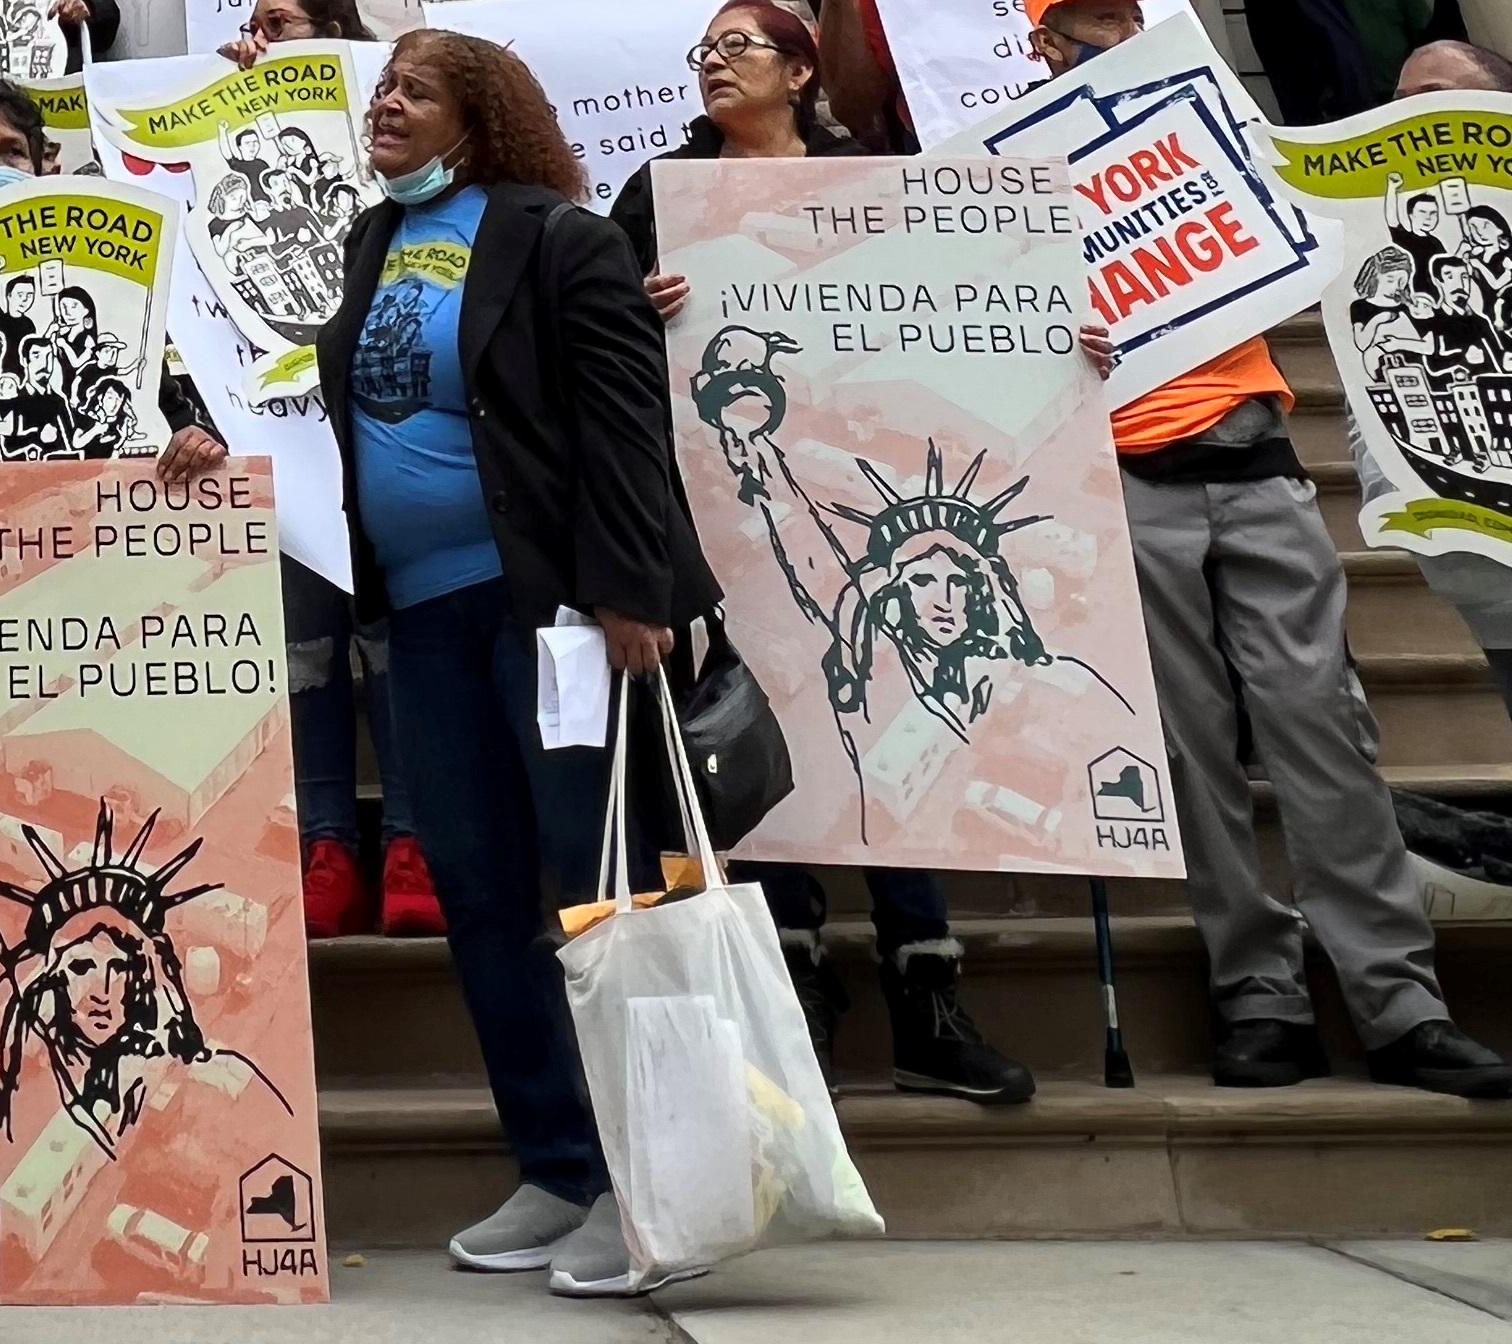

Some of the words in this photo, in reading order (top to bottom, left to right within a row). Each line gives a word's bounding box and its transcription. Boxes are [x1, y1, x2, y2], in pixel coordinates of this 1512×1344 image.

[39, 93, 87, 113] MAK
[148, 98, 215, 136] MAKE
[213, 74, 261, 109] THE
[264, 64, 337, 89] ROAD
[237, 91, 279, 119] NEW
[286, 87, 338, 104] YORK
[573, 85, 688, 116] mother
[599, 124, 667, 155] said
[1303, 141, 1387, 178] MAKE
[1389, 122, 1453, 154] THE
[902, 166, 1053, 195] HOUSE
[1074, 132, 1202, 216] YORK
[1415, 153, 1478, 175] NEW
[65, 206, 153, 243] ROAD
[803, 206, 886, 235] THE
[904, 205, 1073, 234] PEOPLE
[1083, 180, 1207, 264] MUNITIES
[19, 235, 77, 260] NEW
[87, 237, 148, 272] YORK
[1087, 201, 1259, 326] ANGE
[721, 283, 938, 318] ¡VIVIENDA
[955, 284, 1072, 314] PARA
[834, 324, 881, 352] EL
[96, 476, 252, 512] HOUSE
[95, 521, 268, 558] PEOPLE
[141, 613, 262, 649] PARA
[9, 665, 60, 700] EL
[78, 659, 277, 698] PUEBLO!
[1097, 826, 1171, 852] HJ4A
[242, 1248, 319, 1277] HJ4A
